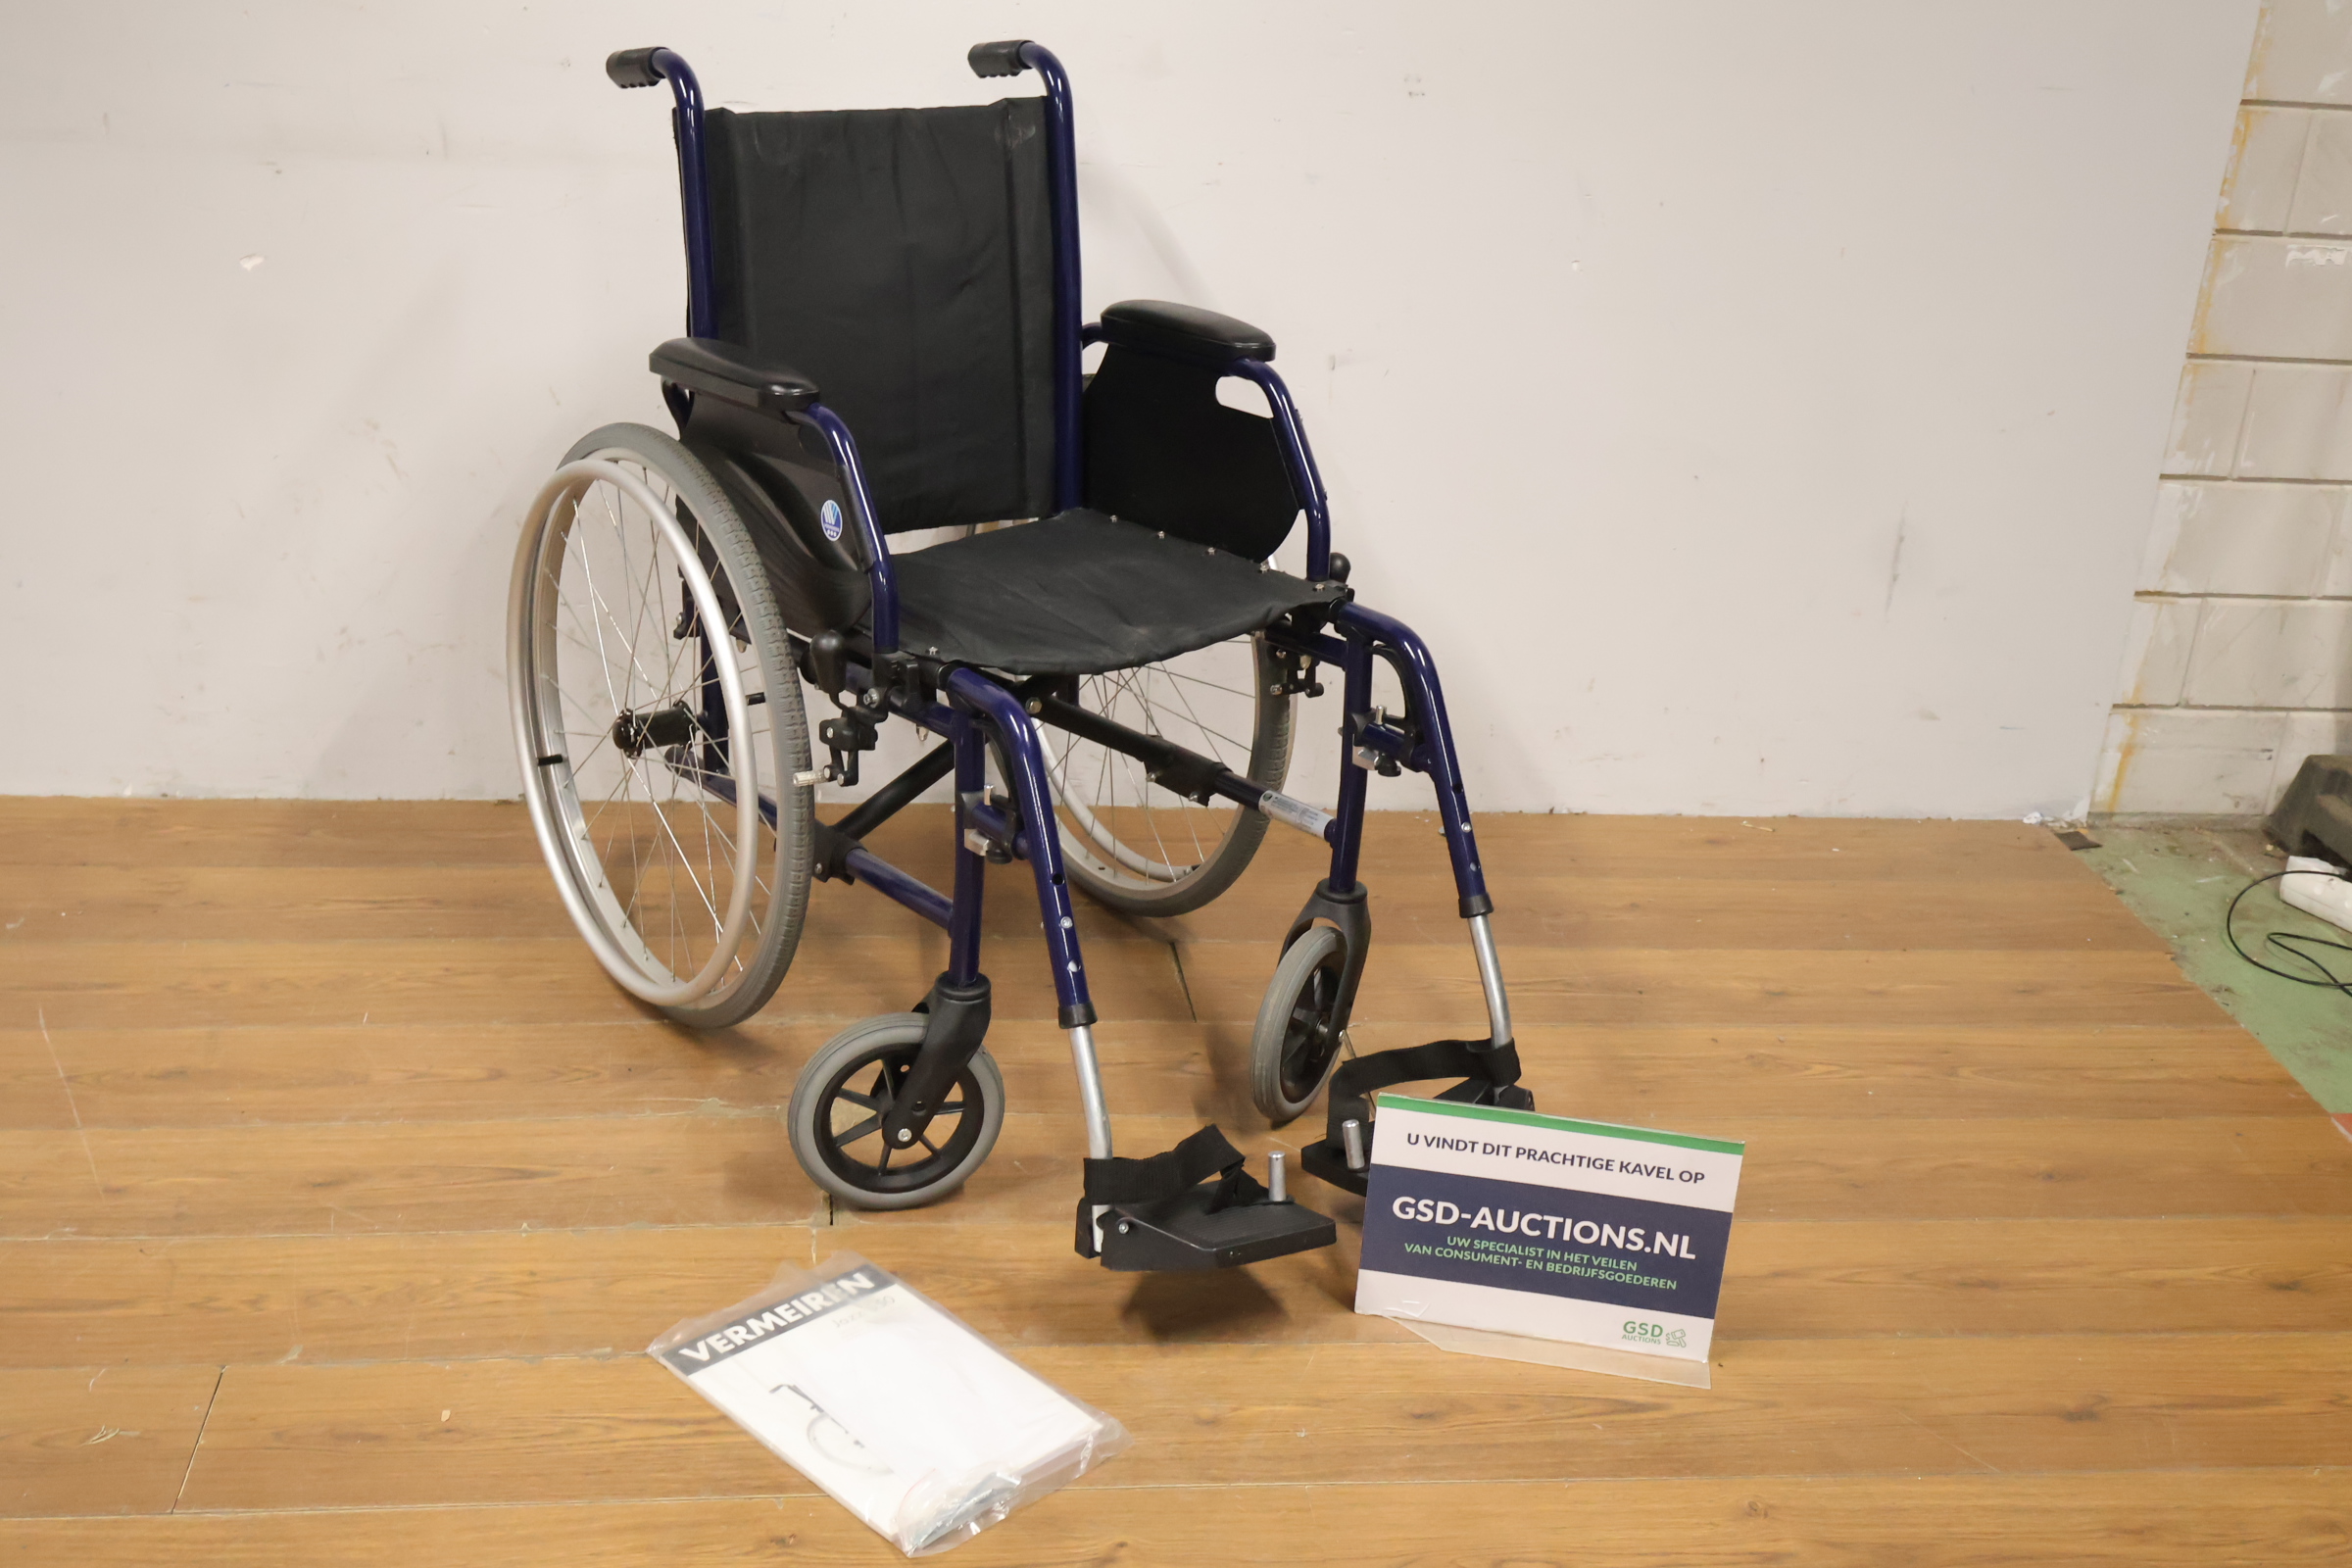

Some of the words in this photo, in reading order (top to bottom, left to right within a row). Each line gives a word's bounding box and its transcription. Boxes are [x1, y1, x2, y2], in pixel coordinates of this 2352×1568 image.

[1407, 1133, 1419, 1146] U
[1424, 1135, 1479, 1153] VINDT
[1482, 1143, 1512, 1157] DIT
[1515, 1147, 1615, 1172] PRACHTIGE
[1619, 1160, 1675, 1180] KAVEL
[1679, 1170, 1705, 1184] OP
[1393, 1196, 1696, 1260] GSD-AUCTIONS.NL
[1404, 1243, 1432, 1255] VAN
[1435, 1248, 1522, 1267] CONSUMENT-
[1525, 1259, 1544, 1271] EN
[1546, 1262, 1677, 1290] BEDRIJFSGOEDEREN
[1446, 1236, 1471, 1248] UW
[1473, 1240, 1544, 1257] SPECIALIST
[1546, 1250, 1561, 1260] IN
[1564, 1251, 1590, 1264] HET
[1592, 1255, 1638, 1272] VEILEN
[678, 1272, 875, 1361] VERMEIREN
[1622, 1334, 1662, 1346] AUCTIONS
[1623, 1321, 1663, 1338] GSD
